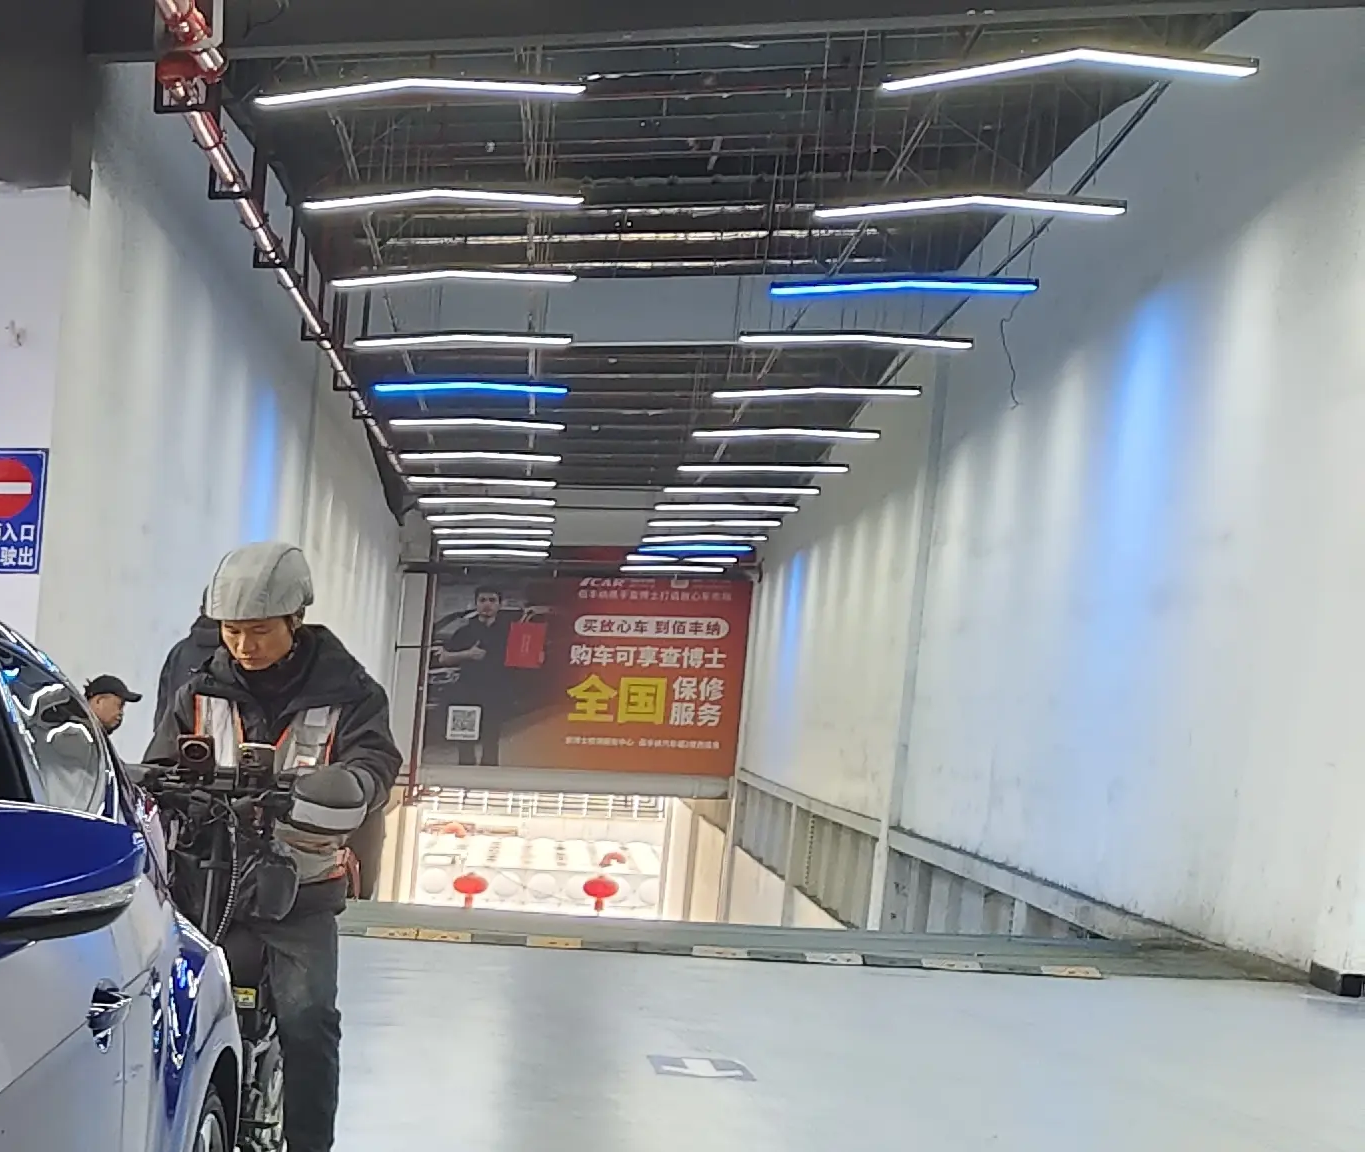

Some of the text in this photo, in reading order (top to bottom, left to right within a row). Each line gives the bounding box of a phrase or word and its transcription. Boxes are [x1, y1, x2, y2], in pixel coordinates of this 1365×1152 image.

[582, 619, 721, 636] 买放心车 到佰丰纳
[569, 644, 727, 669] 购车可享查博士
[566, 674, 668, 725] 全国
[672, 676, 725, 701] 保修
[669, 702, 722, 727] 服务
